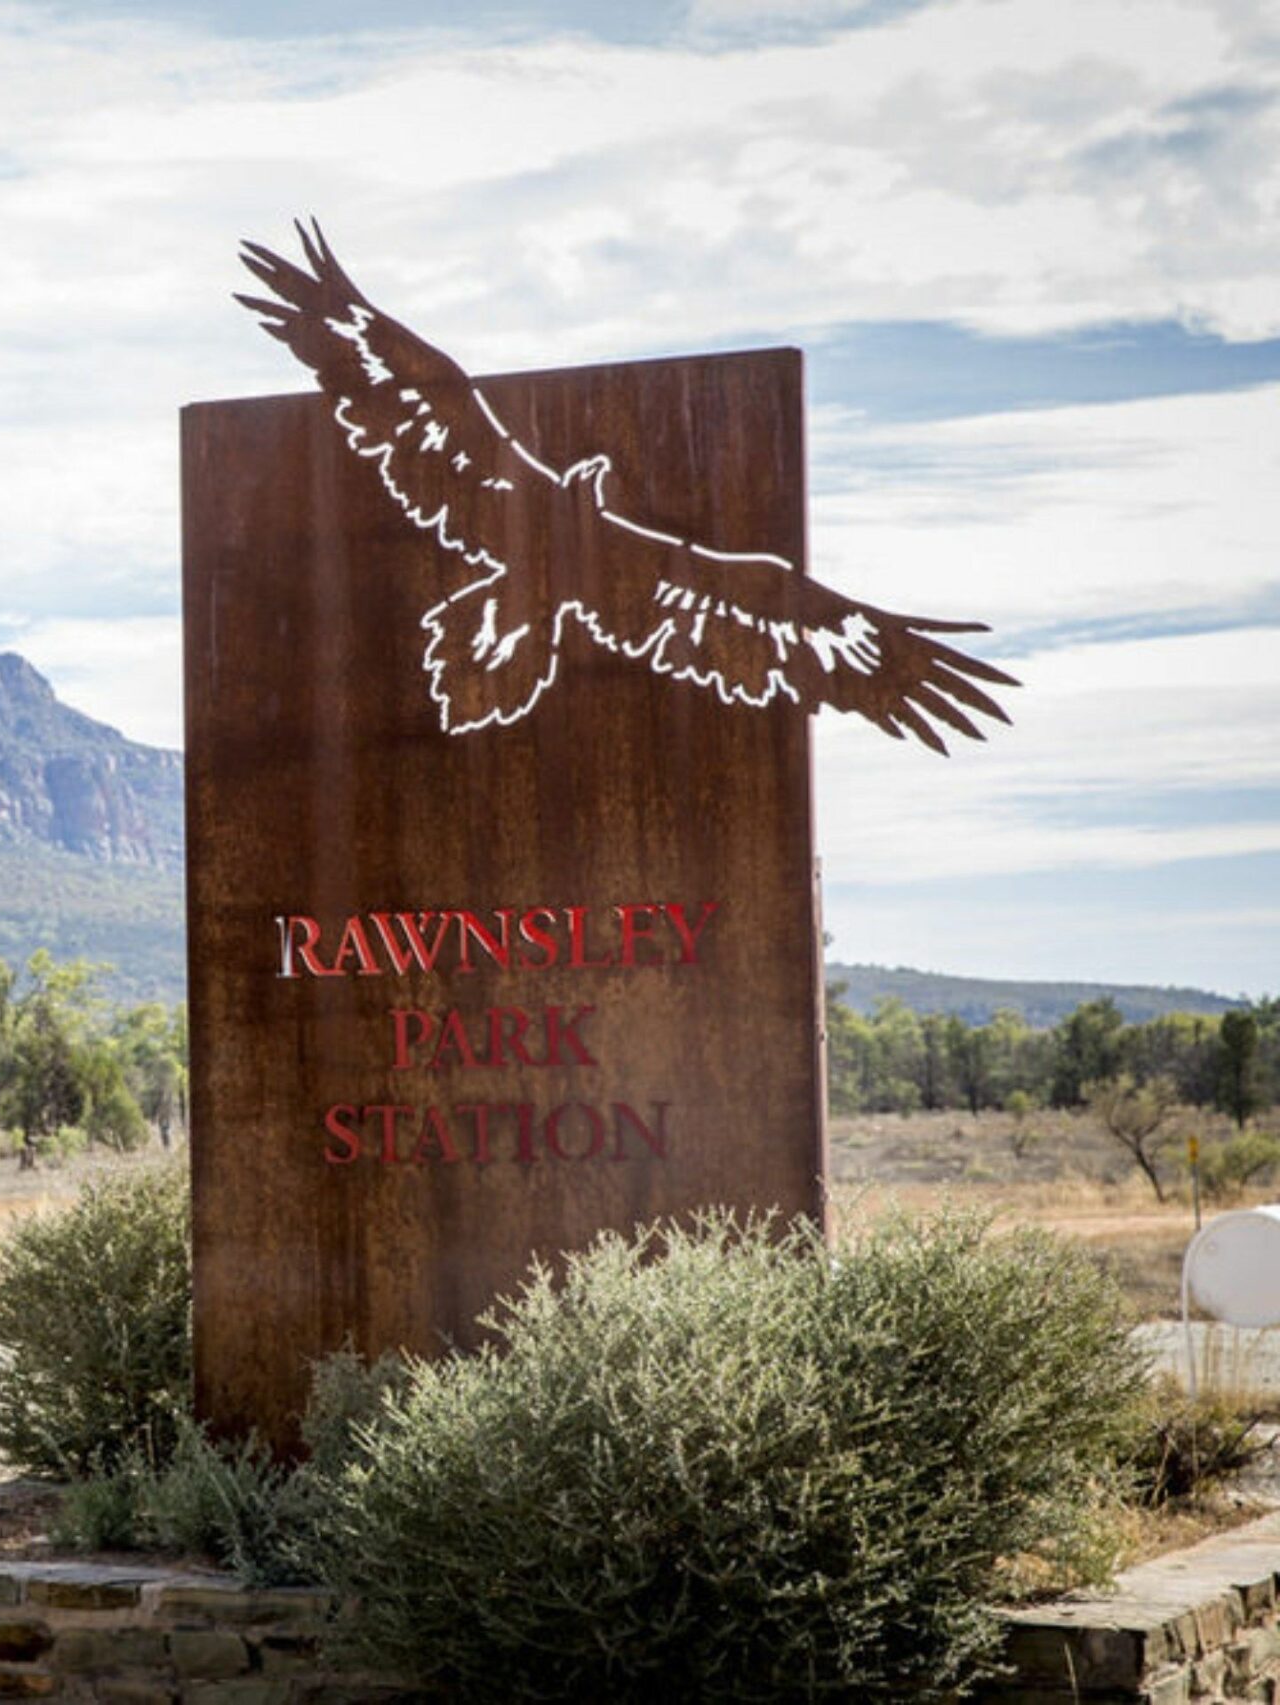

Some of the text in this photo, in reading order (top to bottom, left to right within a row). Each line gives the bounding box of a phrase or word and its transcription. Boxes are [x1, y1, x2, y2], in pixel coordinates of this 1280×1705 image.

[274, 902, 719, 979] RAWNSLEY
[389, 1004, 599, 1071] PARK
[322, 1101, 671, 1164] STATION
